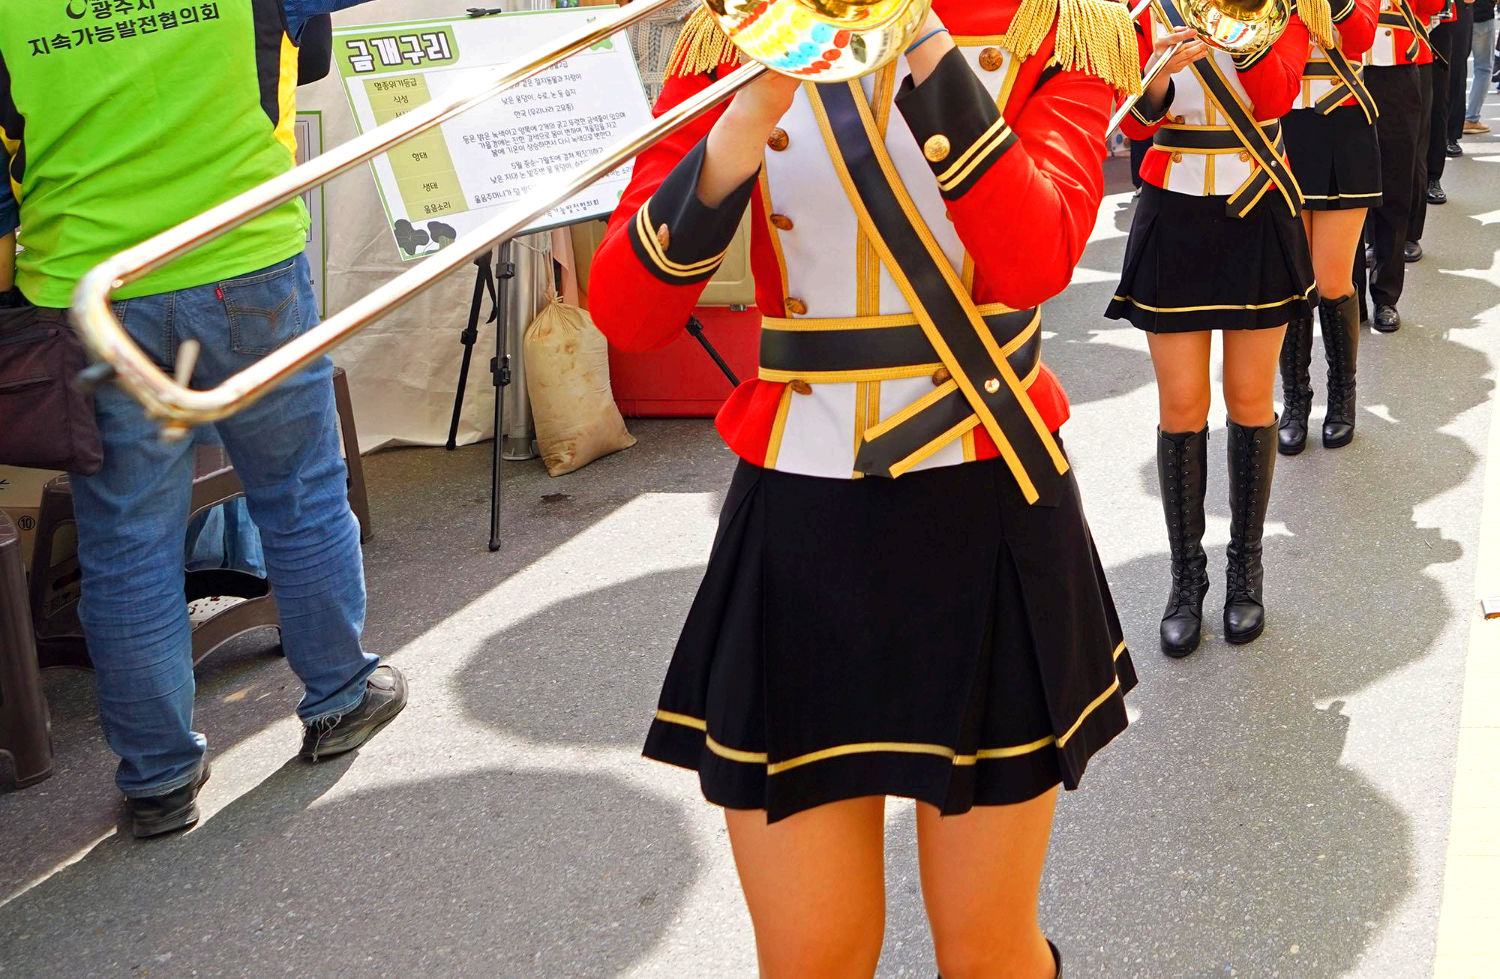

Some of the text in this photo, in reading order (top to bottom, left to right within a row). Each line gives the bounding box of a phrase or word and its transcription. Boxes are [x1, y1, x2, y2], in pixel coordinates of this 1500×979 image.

[27, 2, 221, 57] 지속가능발전협의회
[346, 31, 453, 73] 금개구리
[373, 77, 418, 91] 멸종위기등급
[393, 95, 409, 104] 식성
[513, 109, 529, 119] 한국
[412, 151, 428, 162] 형태
[422, 182, 439, 193] 생태
[424, 201, 452, 214] 울음소리
[546, 197, 600, 218] 속가능발전협의회
